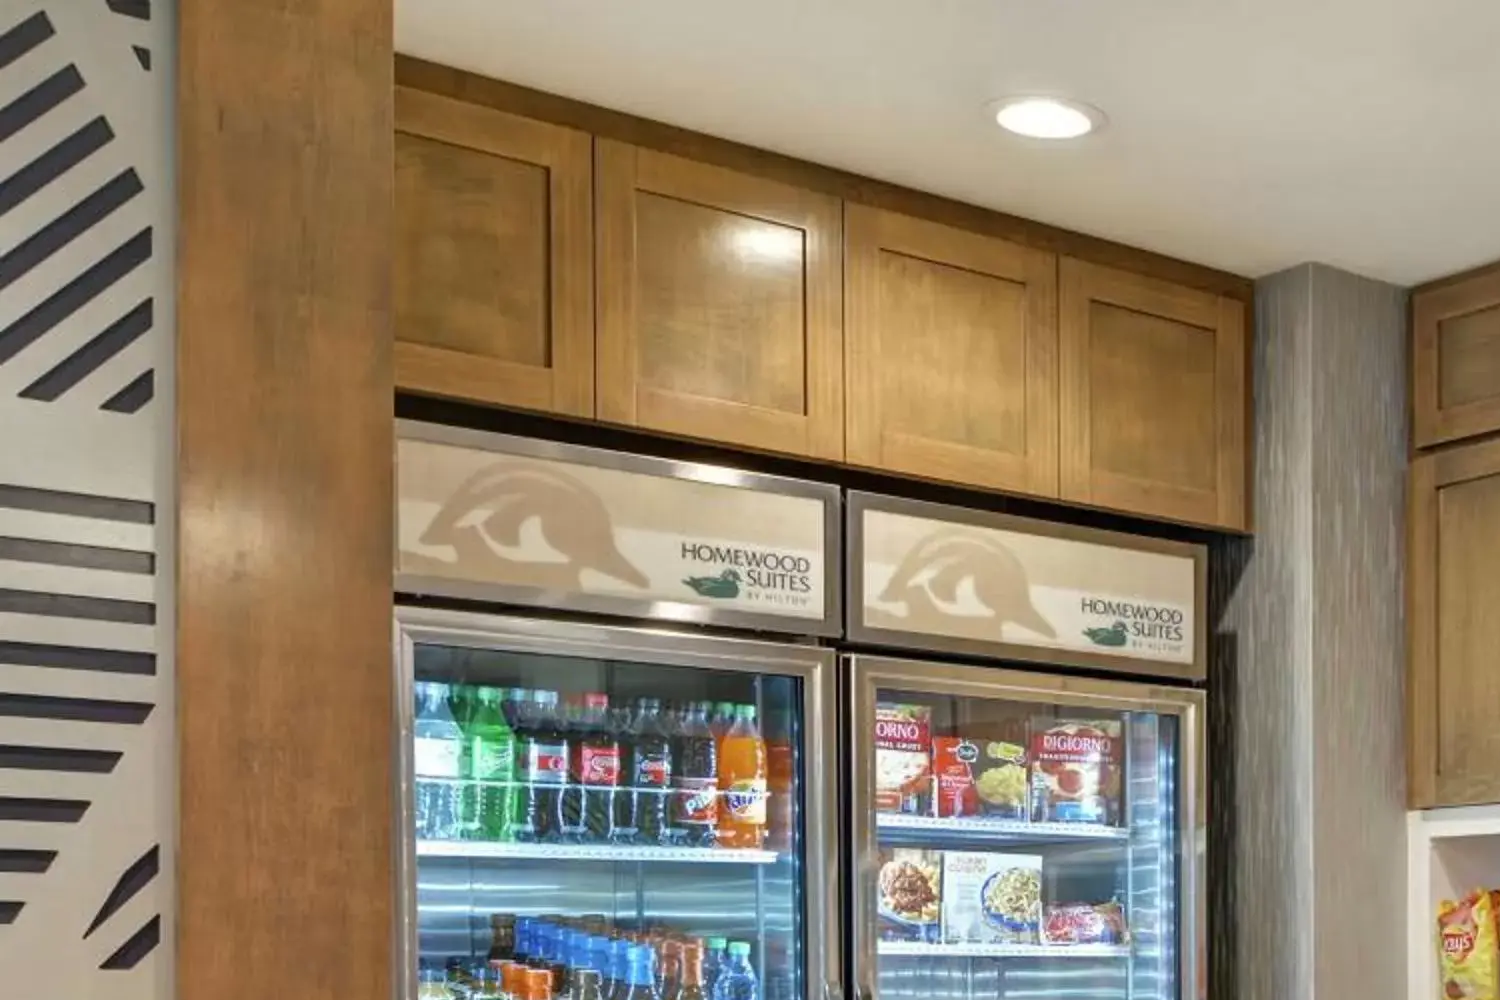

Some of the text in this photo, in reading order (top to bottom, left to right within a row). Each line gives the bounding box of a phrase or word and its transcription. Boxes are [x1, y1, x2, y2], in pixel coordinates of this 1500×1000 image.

[681, 542, 811, 573] HOMEWOOD
[747, 569, 811, 593] SUITES
[1081, 598, 1182, 625] HOMEWOOD
[1132, 621, 1182, 641] SUITES
[1043, 735, 1111, 753] DIGIORNO
